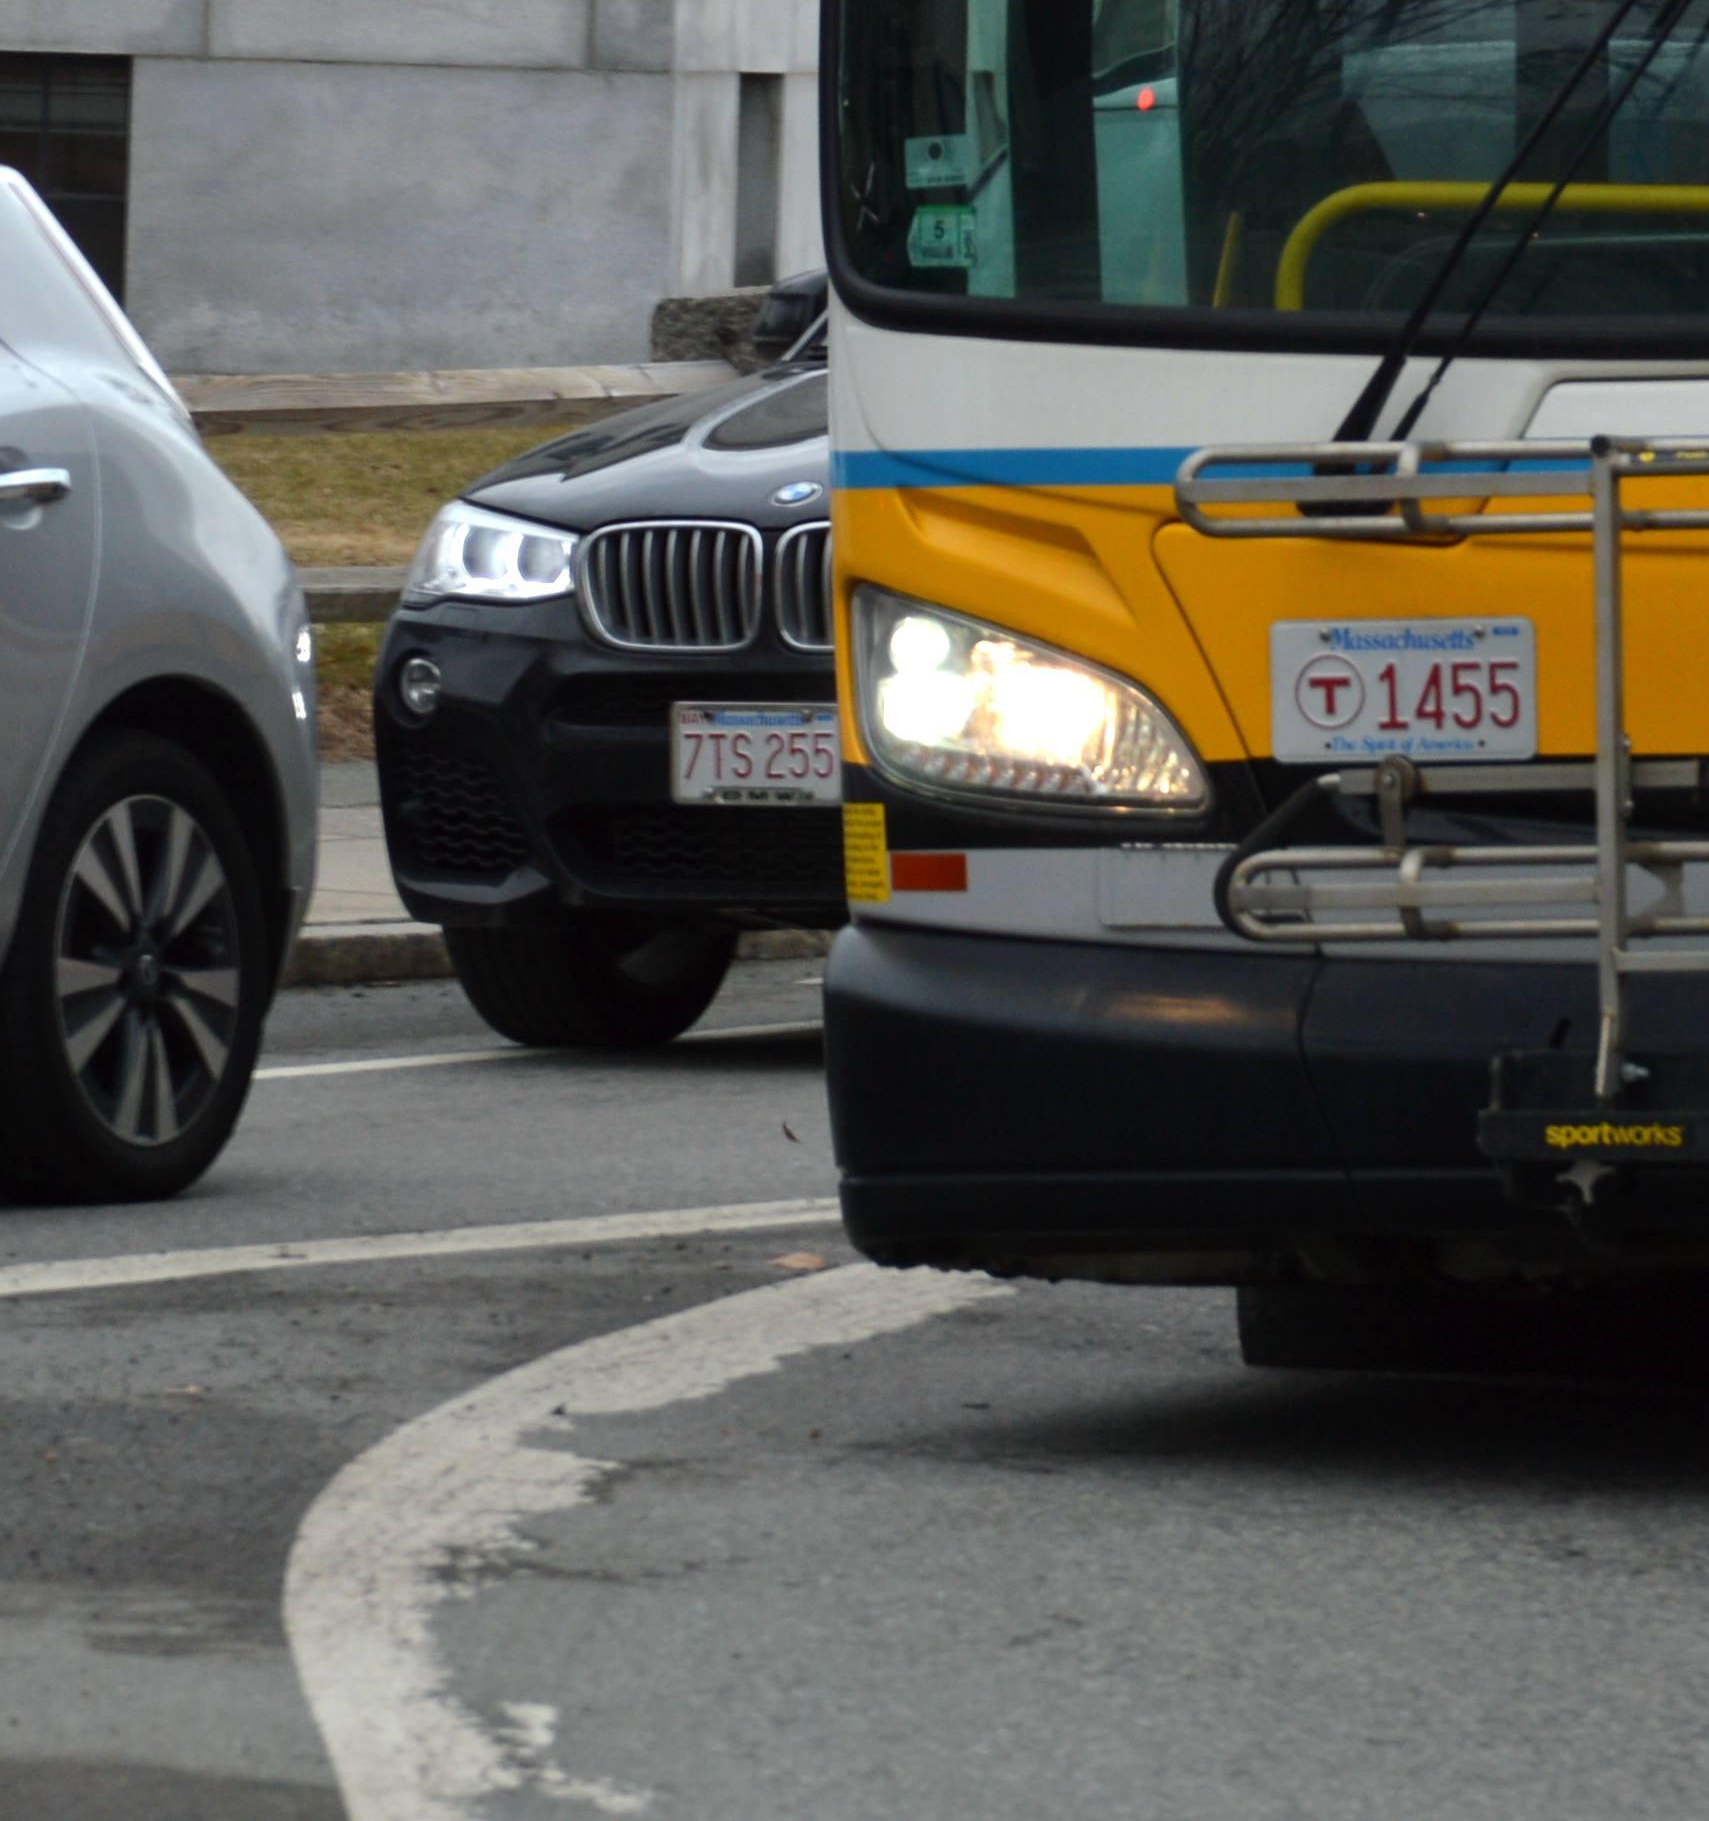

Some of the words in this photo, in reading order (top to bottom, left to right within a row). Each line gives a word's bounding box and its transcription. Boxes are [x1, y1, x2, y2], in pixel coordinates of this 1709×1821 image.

[1309, 677, 1351, 716] T
[1378, 662, 1520, 730] 1455
[684, 732, 753, 780] 7TS
[765, 732, 834, 780] 255
[1545, 1123, 1683, 1150] sportworks
